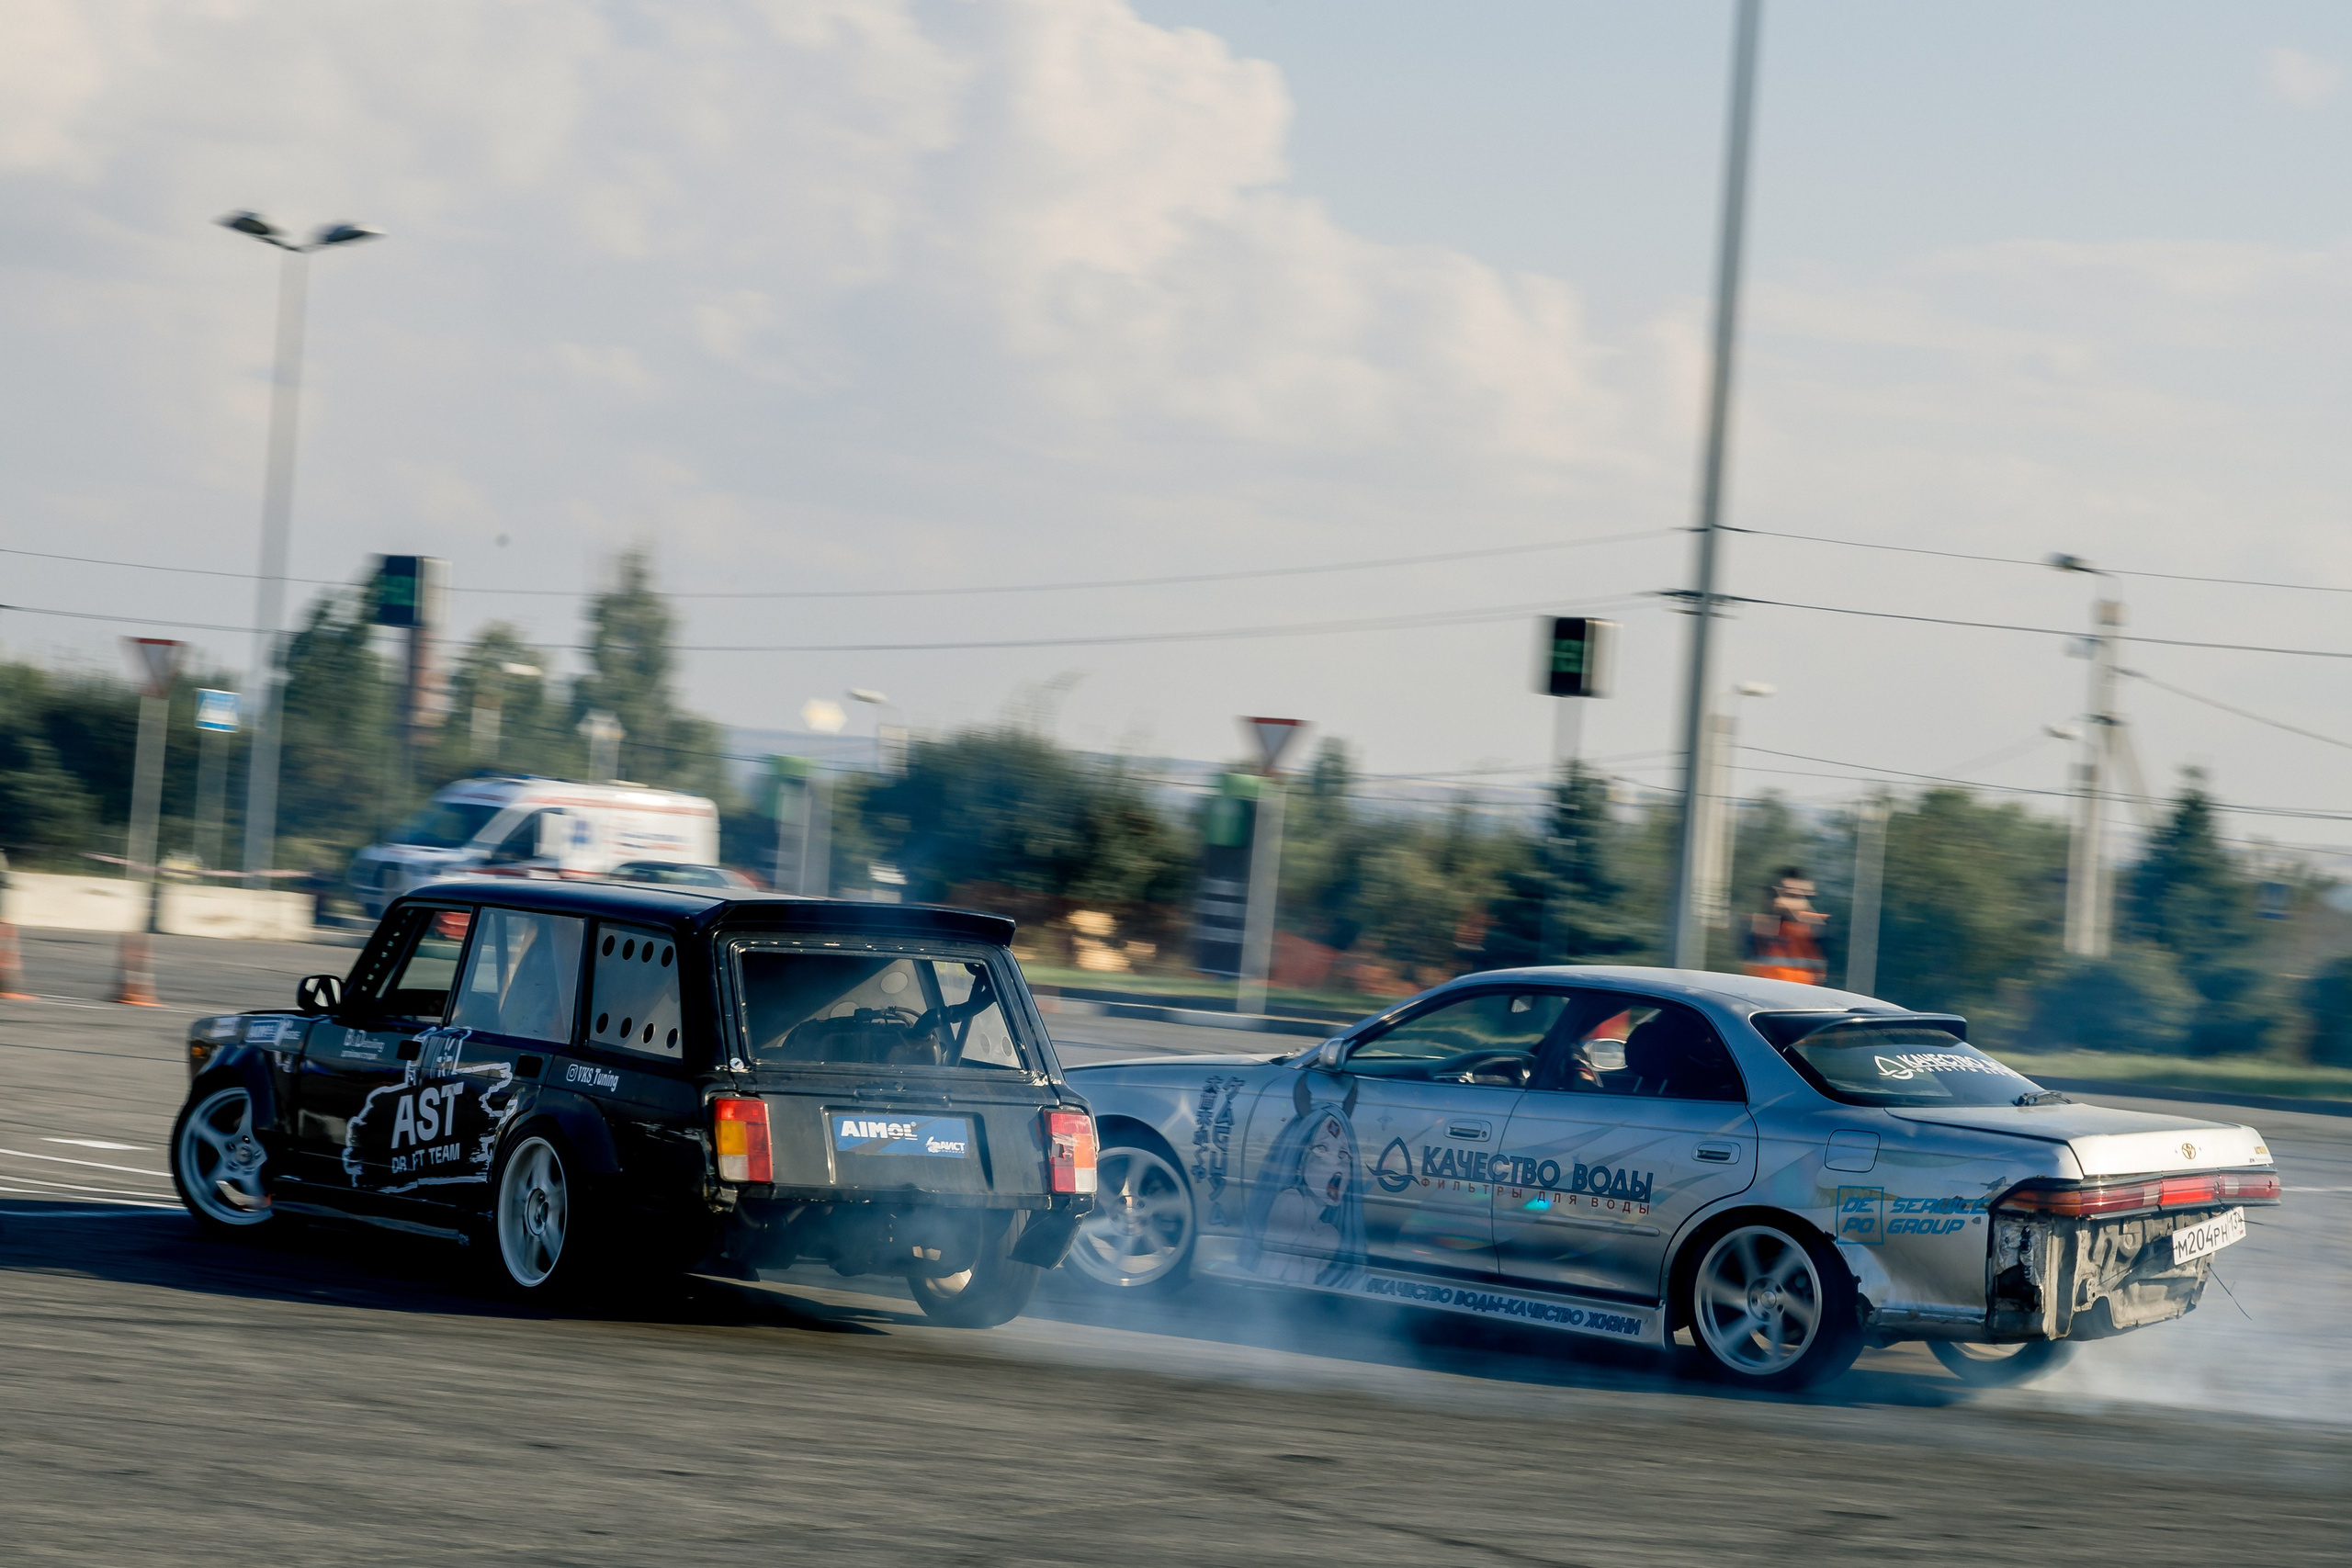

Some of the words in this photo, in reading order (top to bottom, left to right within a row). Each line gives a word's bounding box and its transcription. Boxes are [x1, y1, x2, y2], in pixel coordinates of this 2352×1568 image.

[390, 1081, 465, 1149] AST
[390, 1148, 425, 1174] DRFT
[428, 1142, 460, 1165] TEAM
[1421, 1145, 1561, 1188] КАЧЕСТВО
[1571, 1163, 1654, 1199] ВОДЫ
[1420, 1178, 1522, 1200] ФИЛЬТРЫ
[1537, 1190, 1577, 1205] ДЛЯ
[1590, 1197, 1650, 1215] ВОДЫ
[1886, 1218, 1965, 1235] GROUP
[1584, 1311, 1643, 1337] ЖИЗНИ
